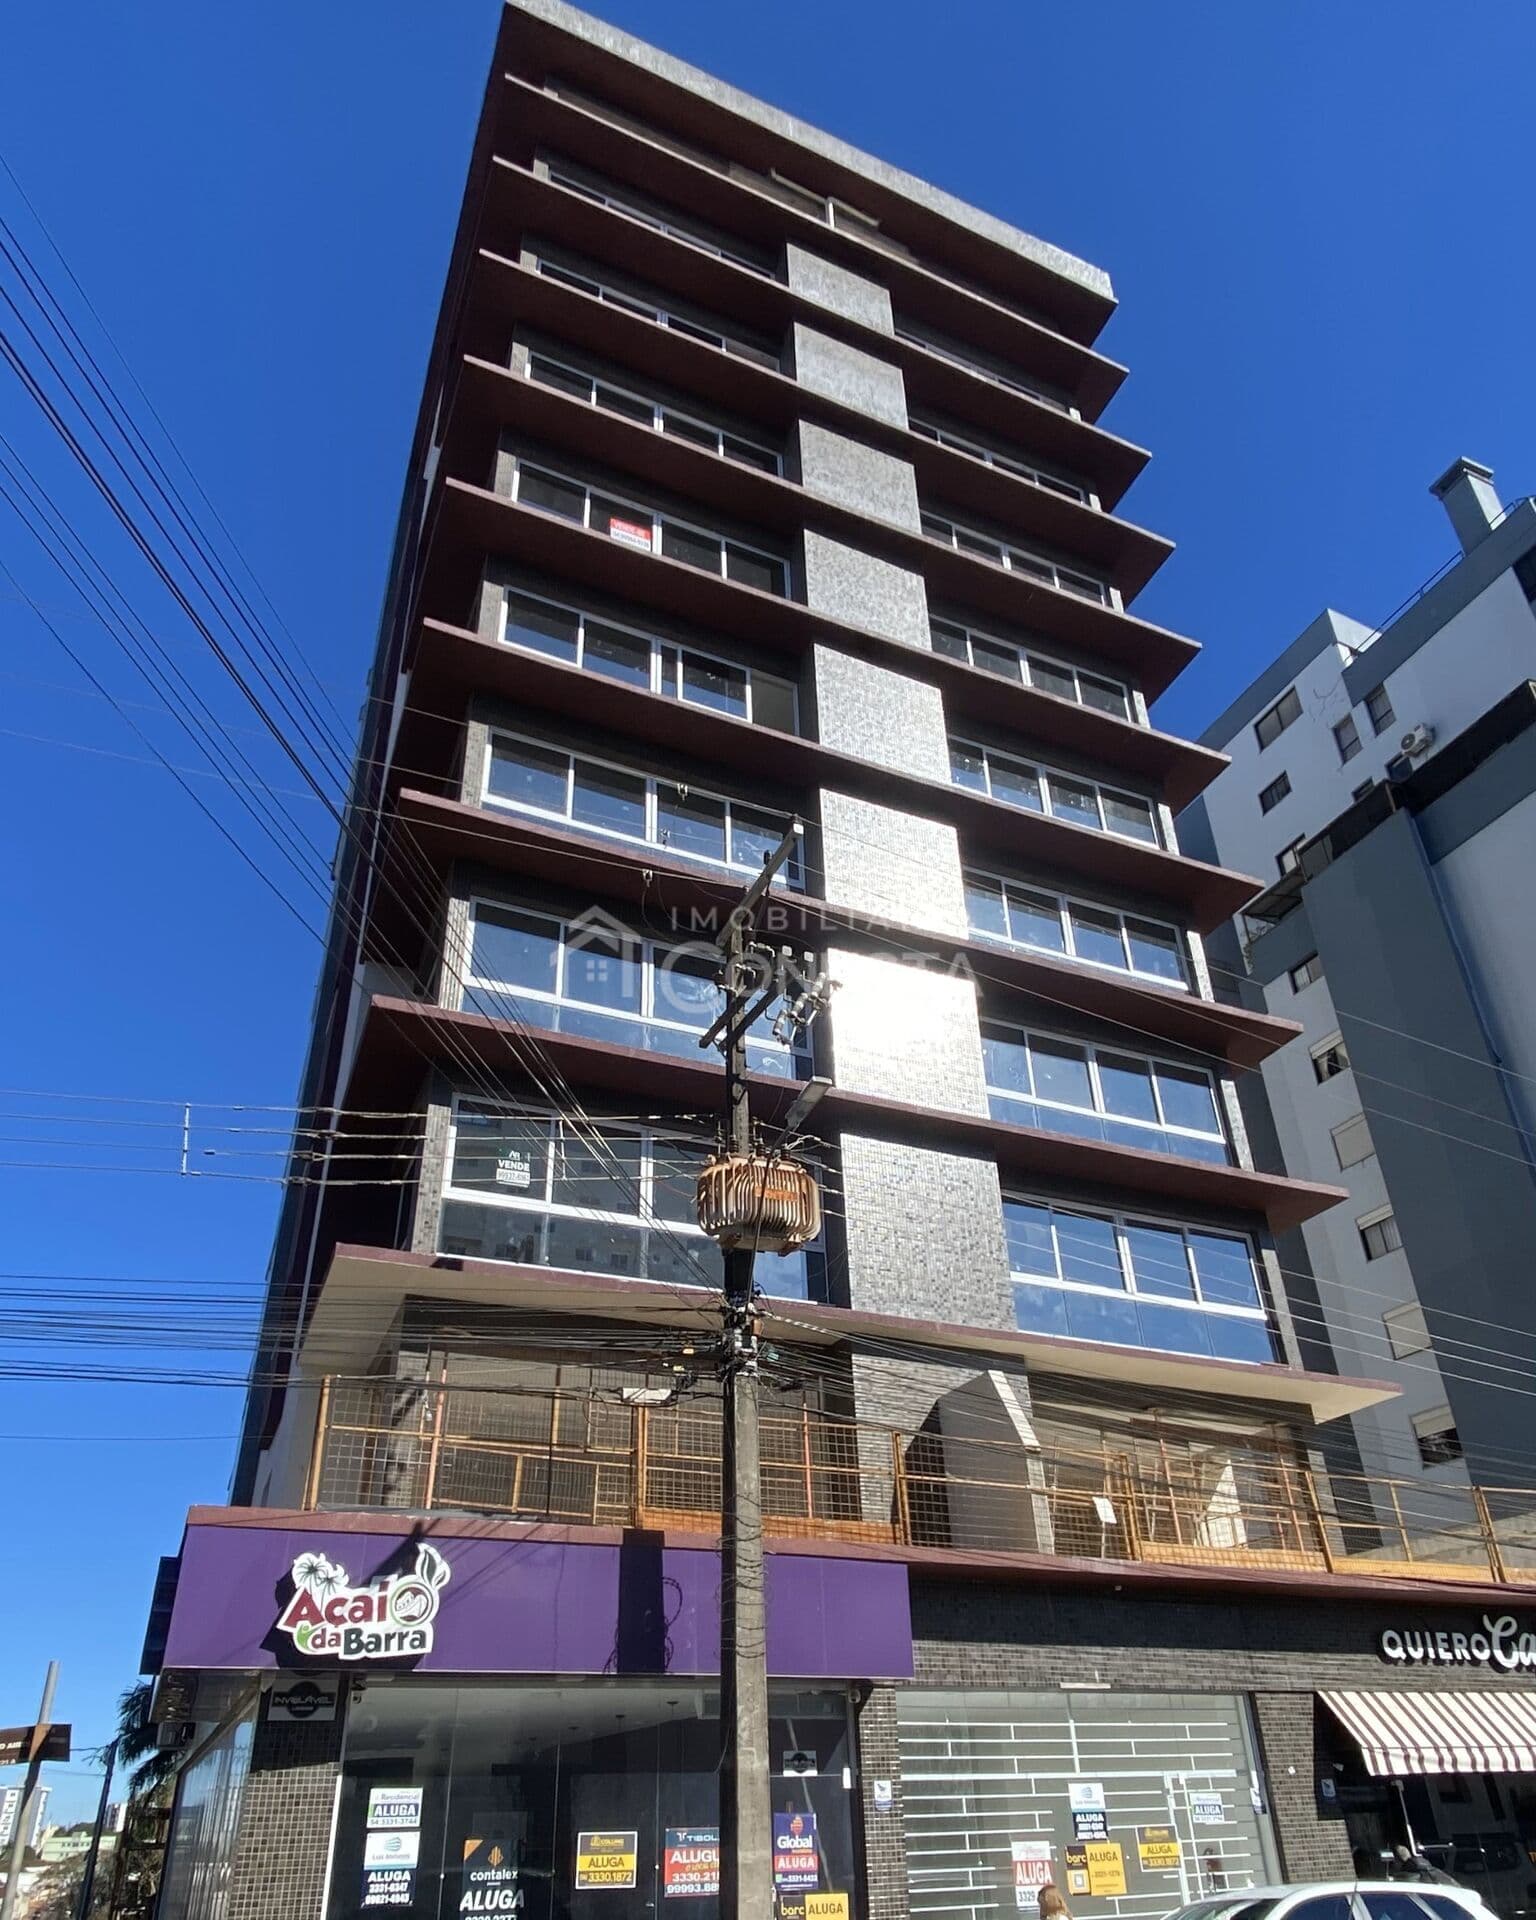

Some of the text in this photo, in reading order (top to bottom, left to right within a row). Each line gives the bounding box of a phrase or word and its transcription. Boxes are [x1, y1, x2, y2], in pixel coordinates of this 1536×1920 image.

[498, 1159, 530, 1172] VENDE
[311, 1627, 427, 1655] da Barra
[1382, 1629, 1491, 1660] QUIERO
[374, 1804, 416, 1817] ALUGA
[1195, 1804, 1221, 1815] ALUGA
[1076, 1813, 1105, 1823] ALUGA
[777, 1834, 813, 1849] Global
[1147, 1845, 1172, 1855] ALUGA
[588, 1856, 625, 1868] ALUGA
[778, 1857, 815, 1869] ALUGA
[1090, 1852, 1118, 1862] ALUGA
[367, 1870, 411, 1883] ALUGA
[470, 1869, 518, 1881] contalex
[1016, 1861, 1053, 1885] ALUGA
[460, 1889, 525, 1912] ALUGA
[808, 1903, 844, 1915] ALUGA
